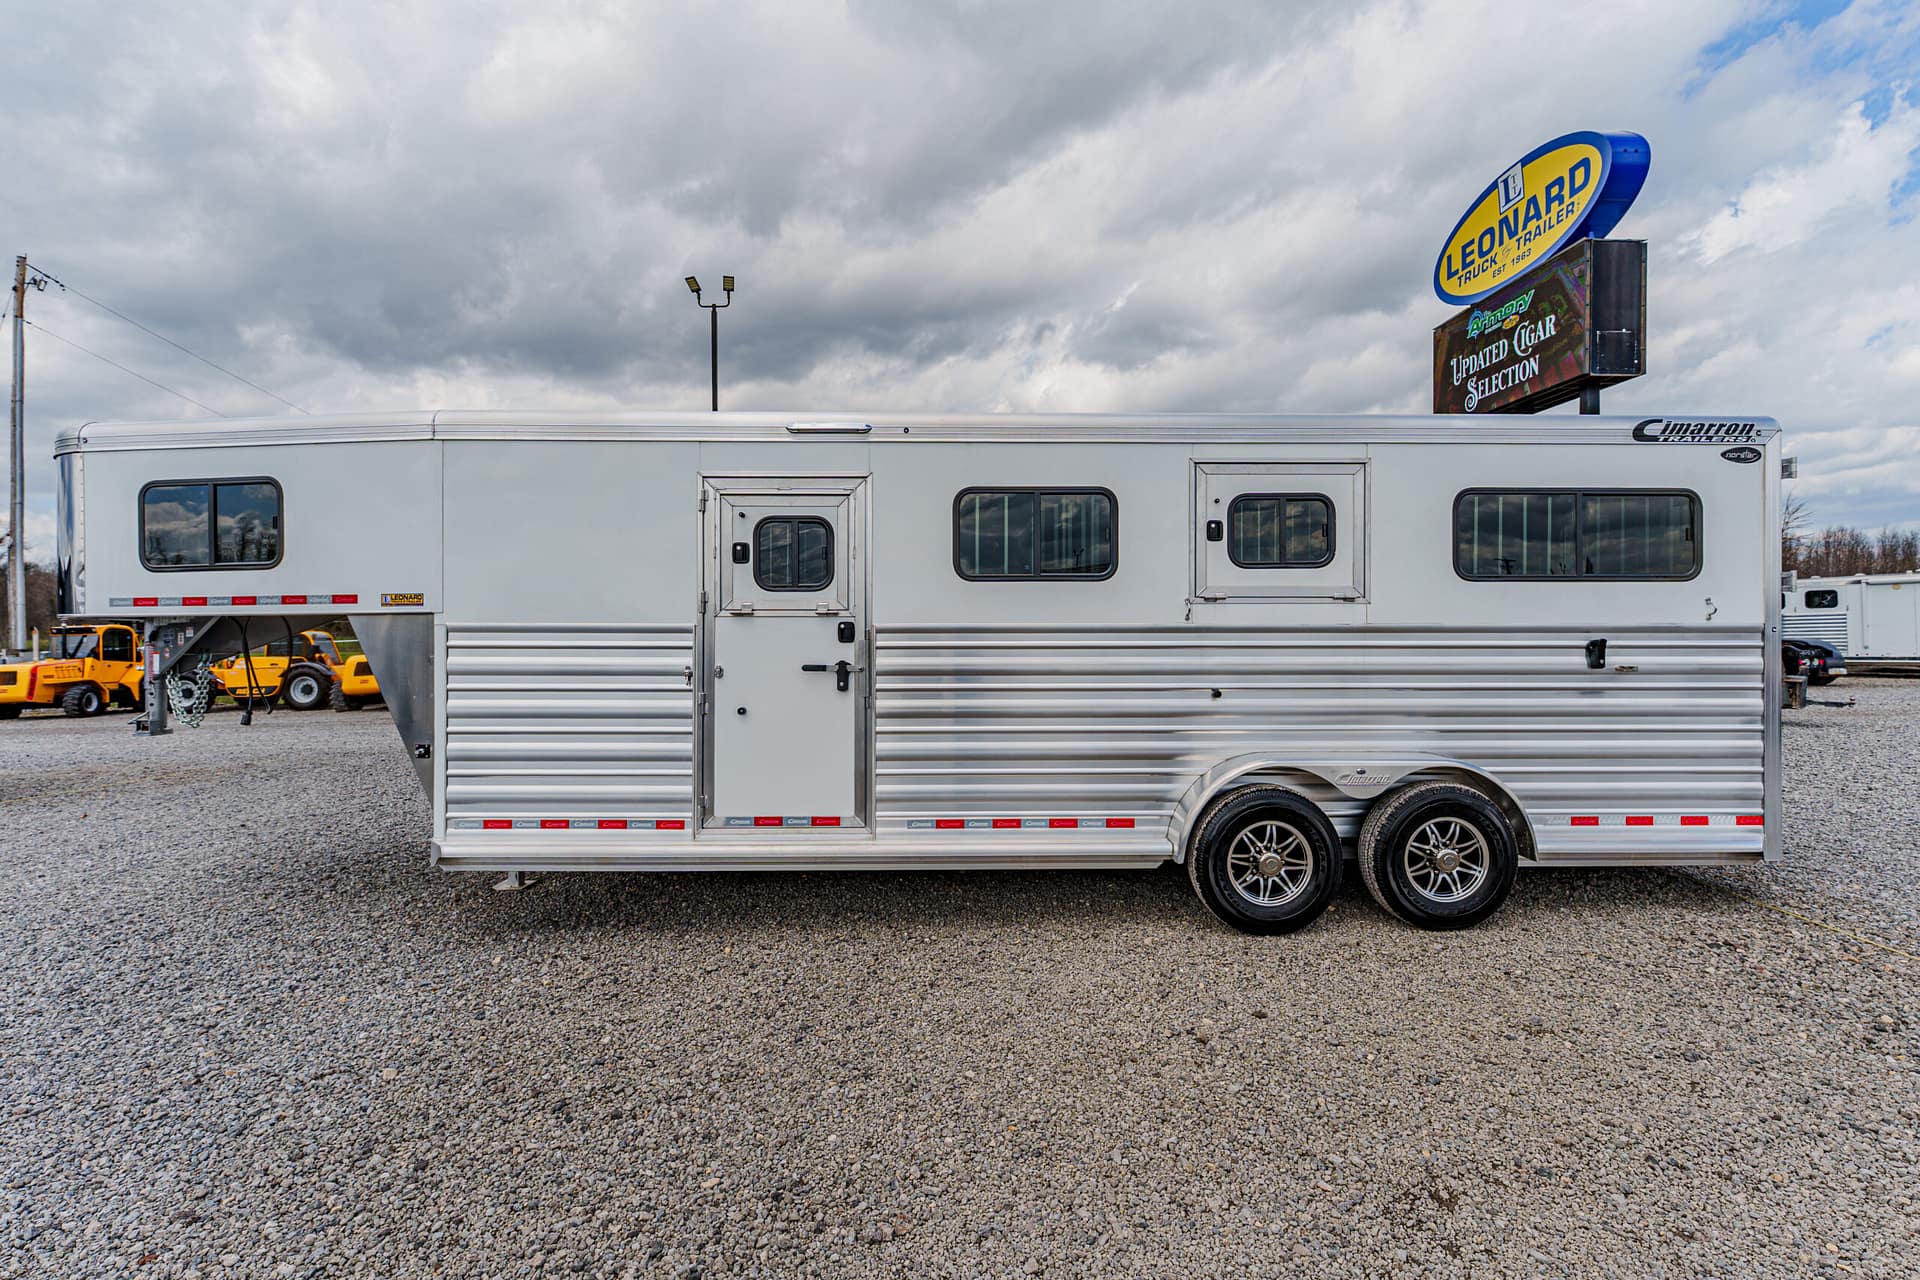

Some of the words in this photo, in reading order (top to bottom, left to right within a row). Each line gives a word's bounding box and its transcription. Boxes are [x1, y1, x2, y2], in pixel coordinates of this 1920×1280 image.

[1446, 156, 1591, 281] LEONARD
[1457, 252, 1498, 287] TRUCK
[1515, 200, 1575, 250] TRAILER
[1492, 263, 1506, 278] EST
[1511, 247, 1532, 266] 1963
[1466, 289, 1536, 339] Armory
[1632, 418, 1755, 442] Cimarron
[1656, 435, 1750, 443] TRAILERS
